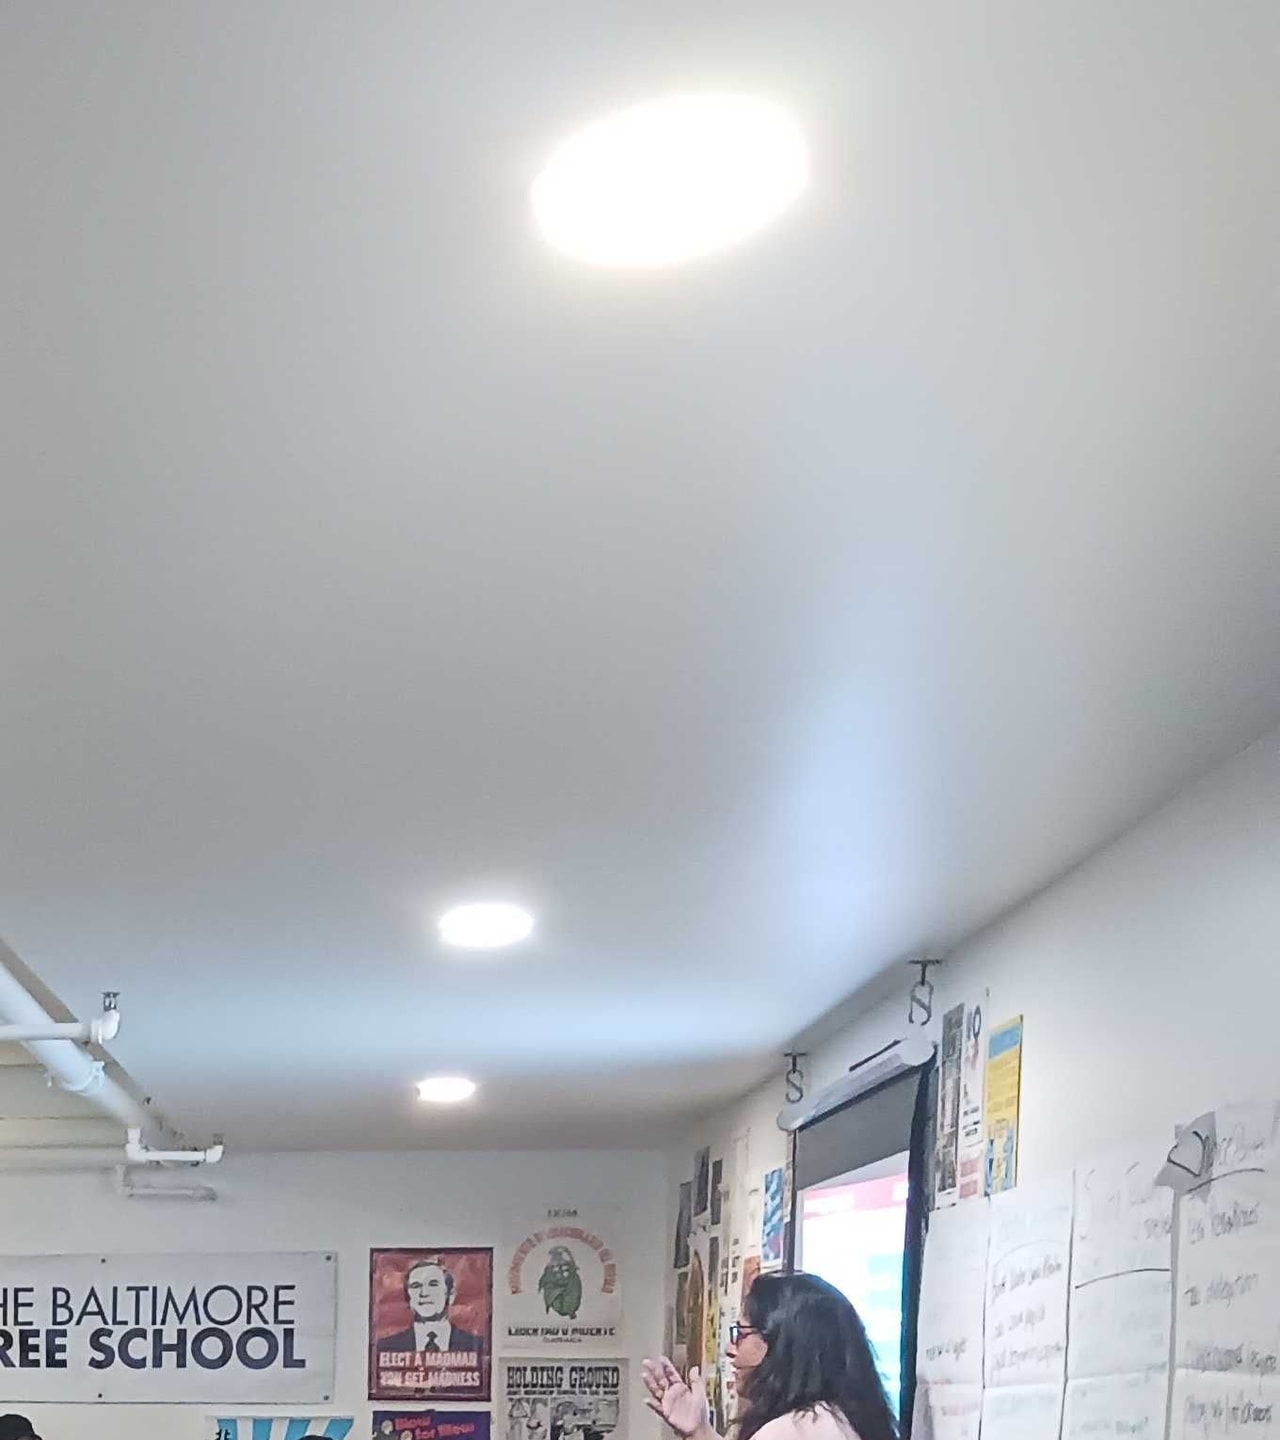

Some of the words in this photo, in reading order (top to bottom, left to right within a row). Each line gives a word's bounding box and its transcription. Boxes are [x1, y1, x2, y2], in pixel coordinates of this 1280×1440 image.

[51, 1284, 296, 1326] BALTIMORE
[88, 1326, 307, 1370] SCHOOL
[379, 1352, 411, 1367] ELECT
[414, 1352, 422, 1367] A
[425, 1352, 478, 1367] MADMAN
[380, 1371, 402, 1387] YOU
[405, 1371, 425, 1387] GET
[428, 1371, 480, 1387] MADNESS
[507, 1366, 564, 1389] HOLDING
[569, 1366, 620, 1389] GROUND
